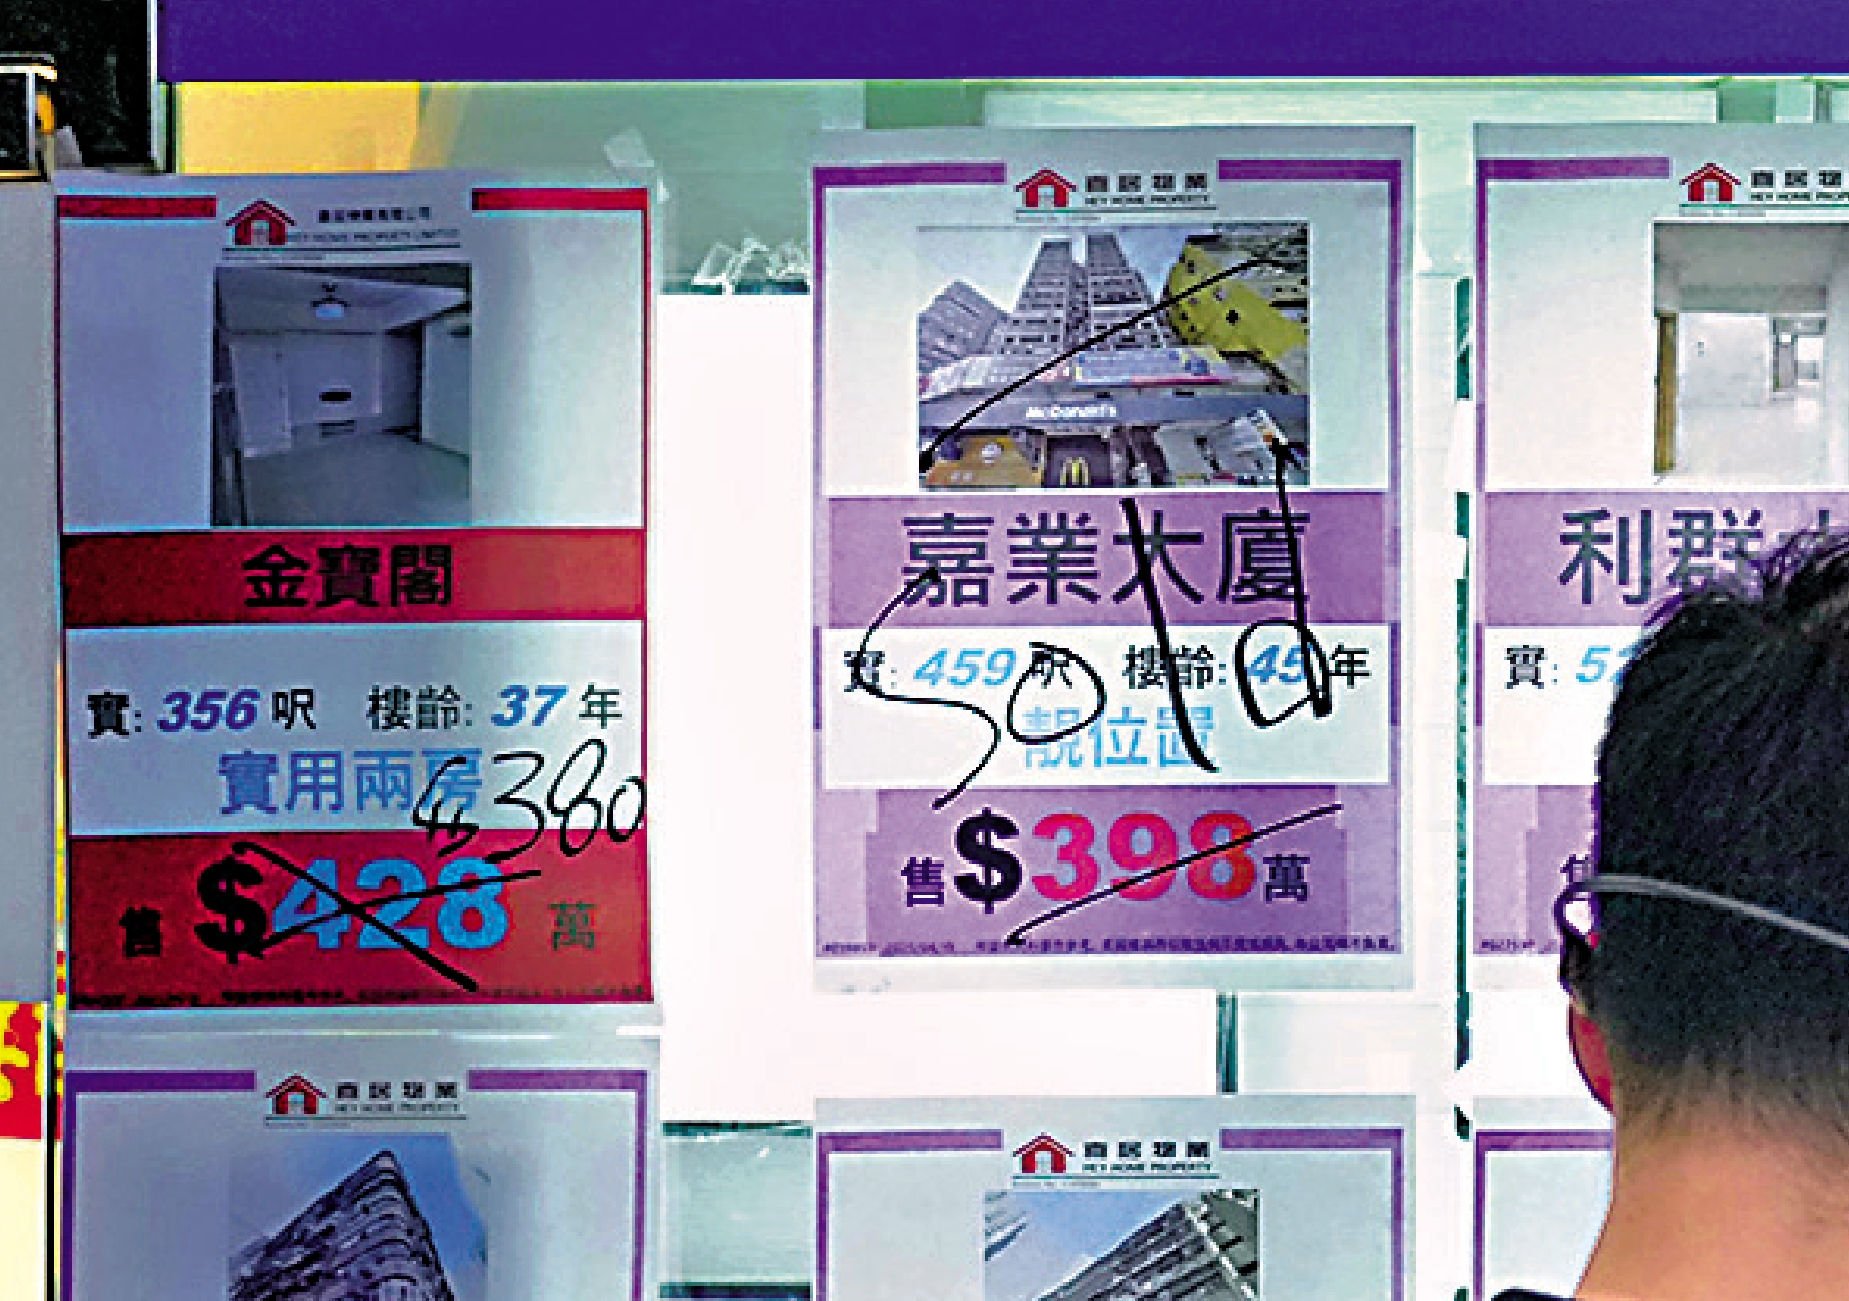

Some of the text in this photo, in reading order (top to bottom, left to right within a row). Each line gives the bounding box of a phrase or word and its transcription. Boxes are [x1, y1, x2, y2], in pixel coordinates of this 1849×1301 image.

[242, 544, 453, 608] 金寶閣
[902, 511, 1309, 607] 嘉業大廈
[914, 649, 1015, 685] 459
[157, 686, 566, 733] 356 37
